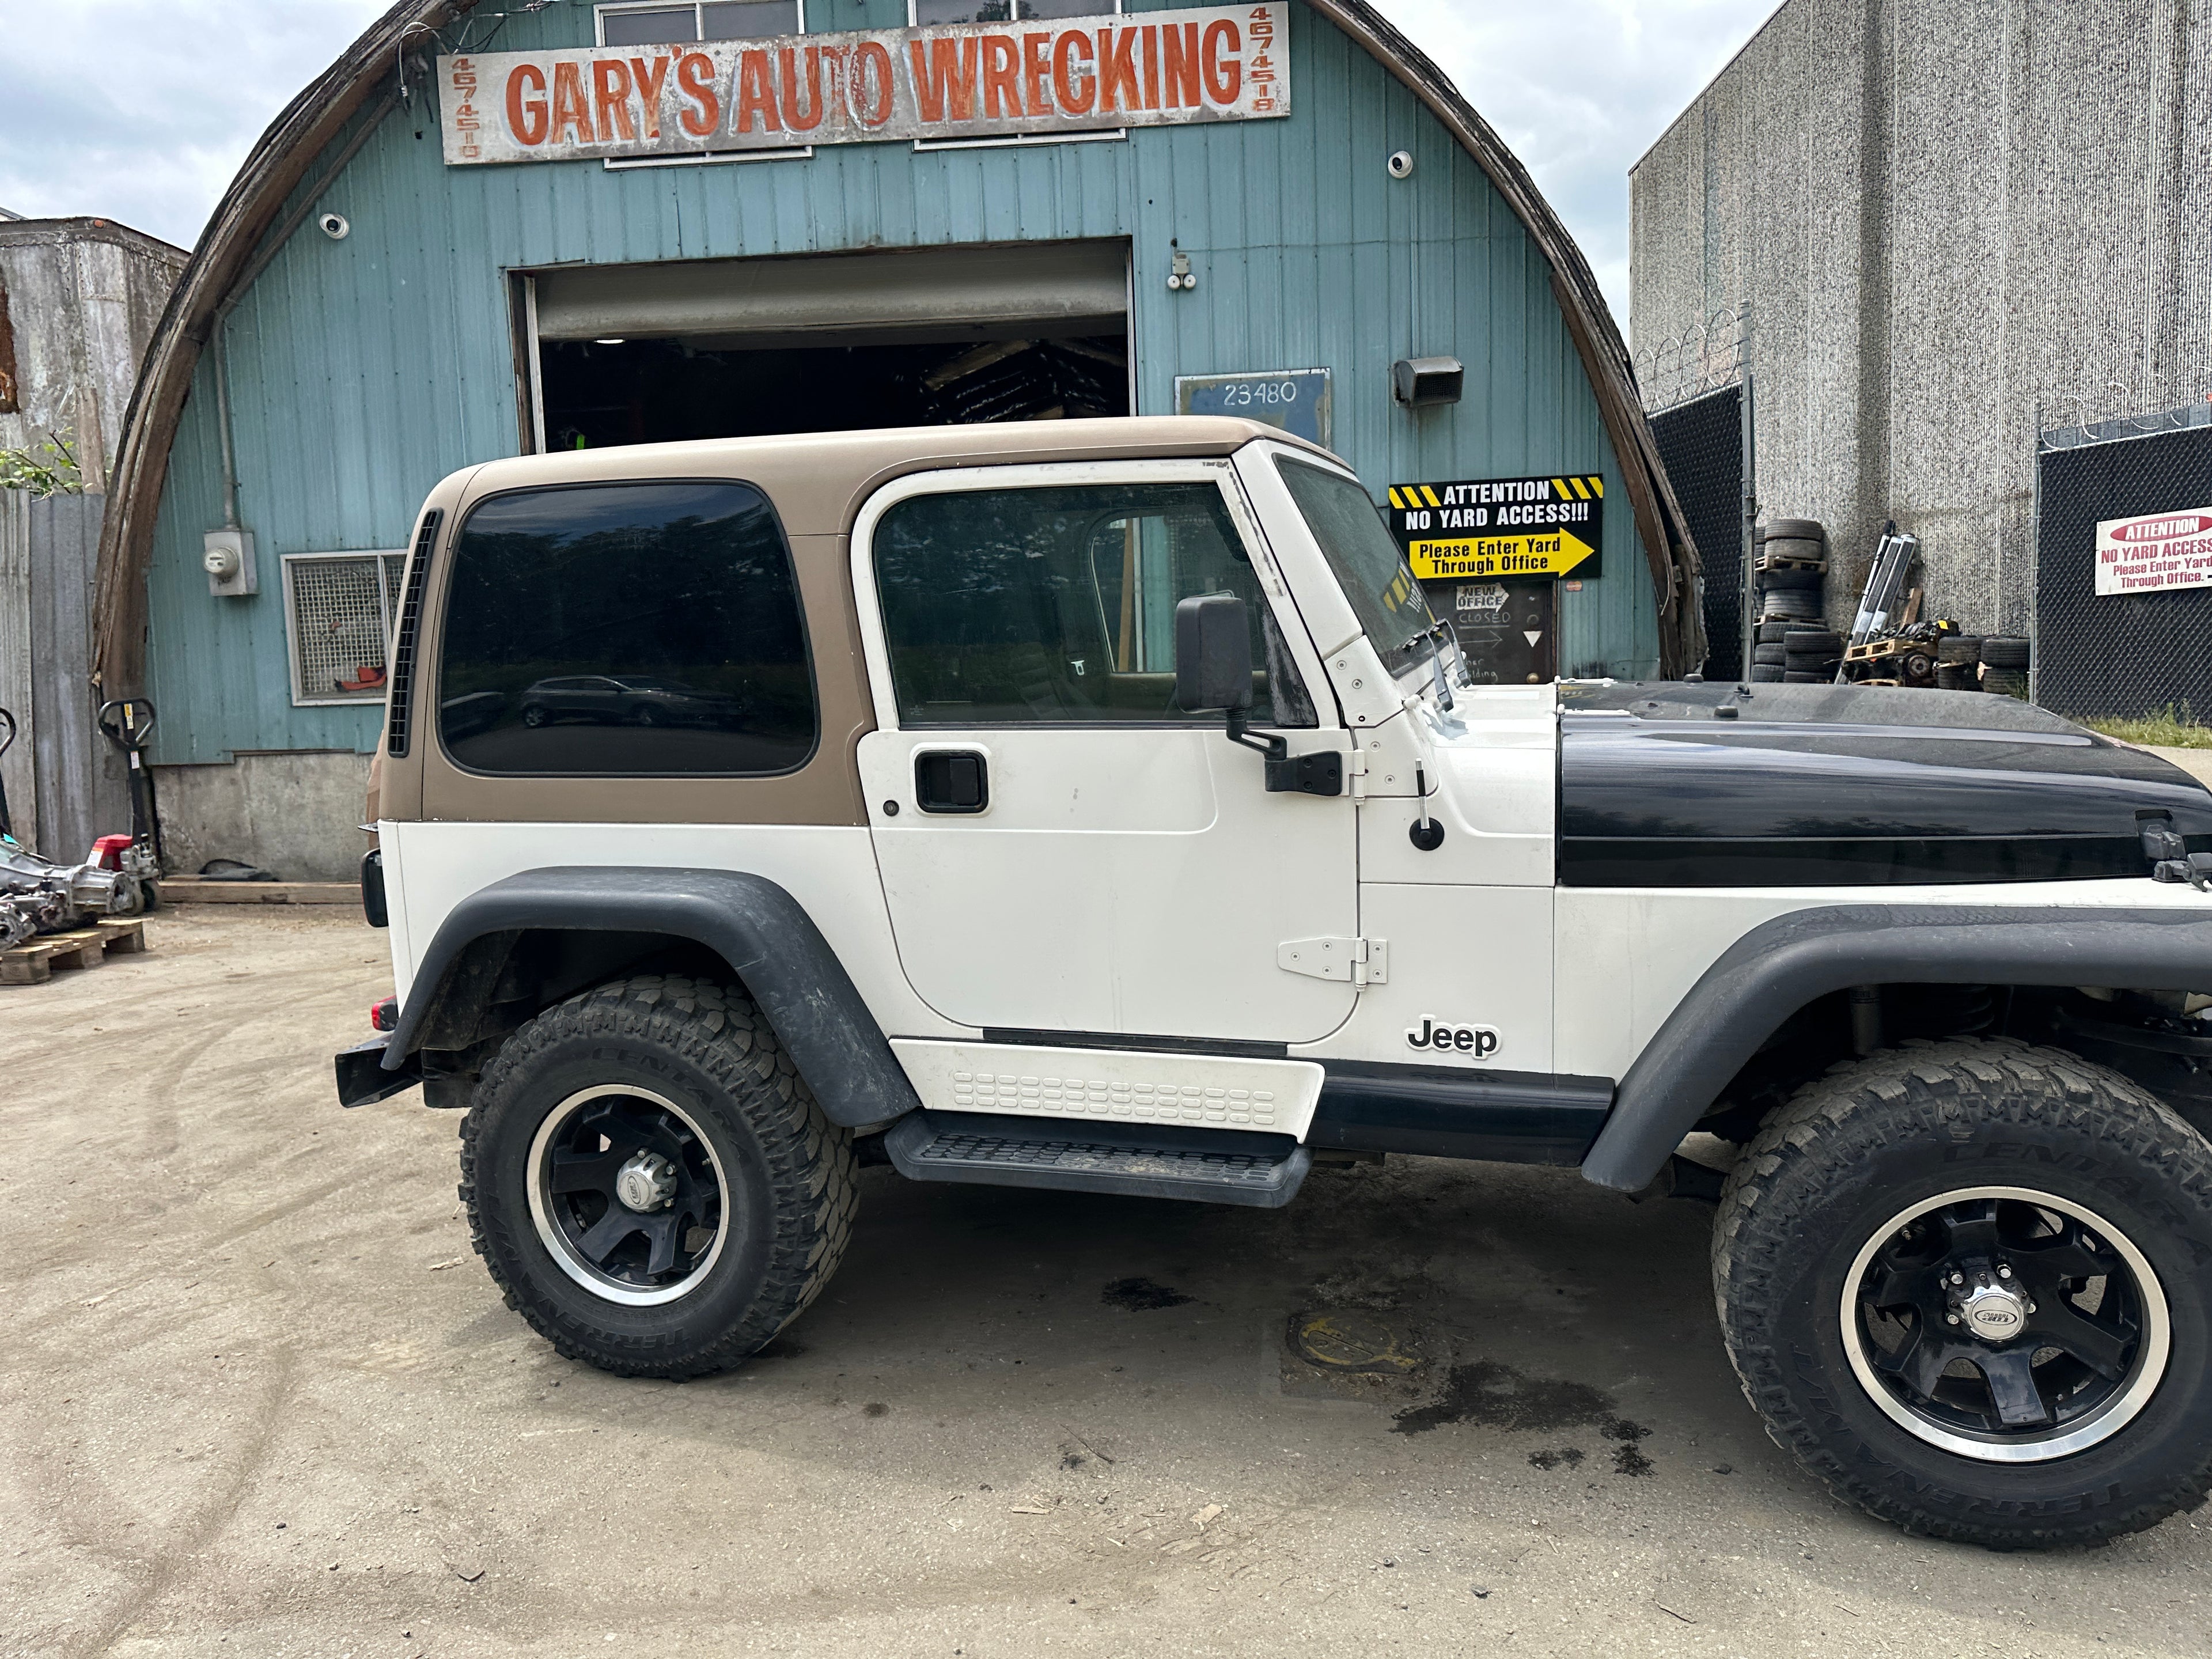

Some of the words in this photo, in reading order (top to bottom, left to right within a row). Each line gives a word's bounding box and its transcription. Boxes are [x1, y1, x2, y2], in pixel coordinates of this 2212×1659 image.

[505, 47, 719, 145] GARY'S
[737, 41, 893, 133] AUTO
[910, 18, 1241, 122] WRECKING
[1224, 381, 1296, 406] 23480
[1444, 480, 1550, 505] ATTENTION
[1406, 510, 1431, 531] NO
[1439, 508, 1488, 528] YARD
[1497, 502, 1589, 525] ACCESS!!!
[2124, 517, 2200, 540] ATTENTION
[1419, 543, 1469, 559] Please
[1477, 540, 1518, 555] Enter
[1526, 537, 1560, 553] Yard
[2101, 548, 2118, 564] NO
[2122, 544, 2158, 562] YARD
[1431, 556, 1494, 575] Through
[1501, 555, 1548, 571] Office
[2113, 564, 2147, 576] Please
[2150, 560, 2181, 572] Enter
[2184, 556, 2212, 569] Yard
[2121, 574, 2164, 588] Through
[2167, 571, 2205, 585] Office.
[1457, 596, 1504, 607] OFFICE
[1464, 586, 1495, 597] NEW
[1459, 612, 1511, 623] CLOSED
[1408, 1019, 1497, 1057] Jeep
